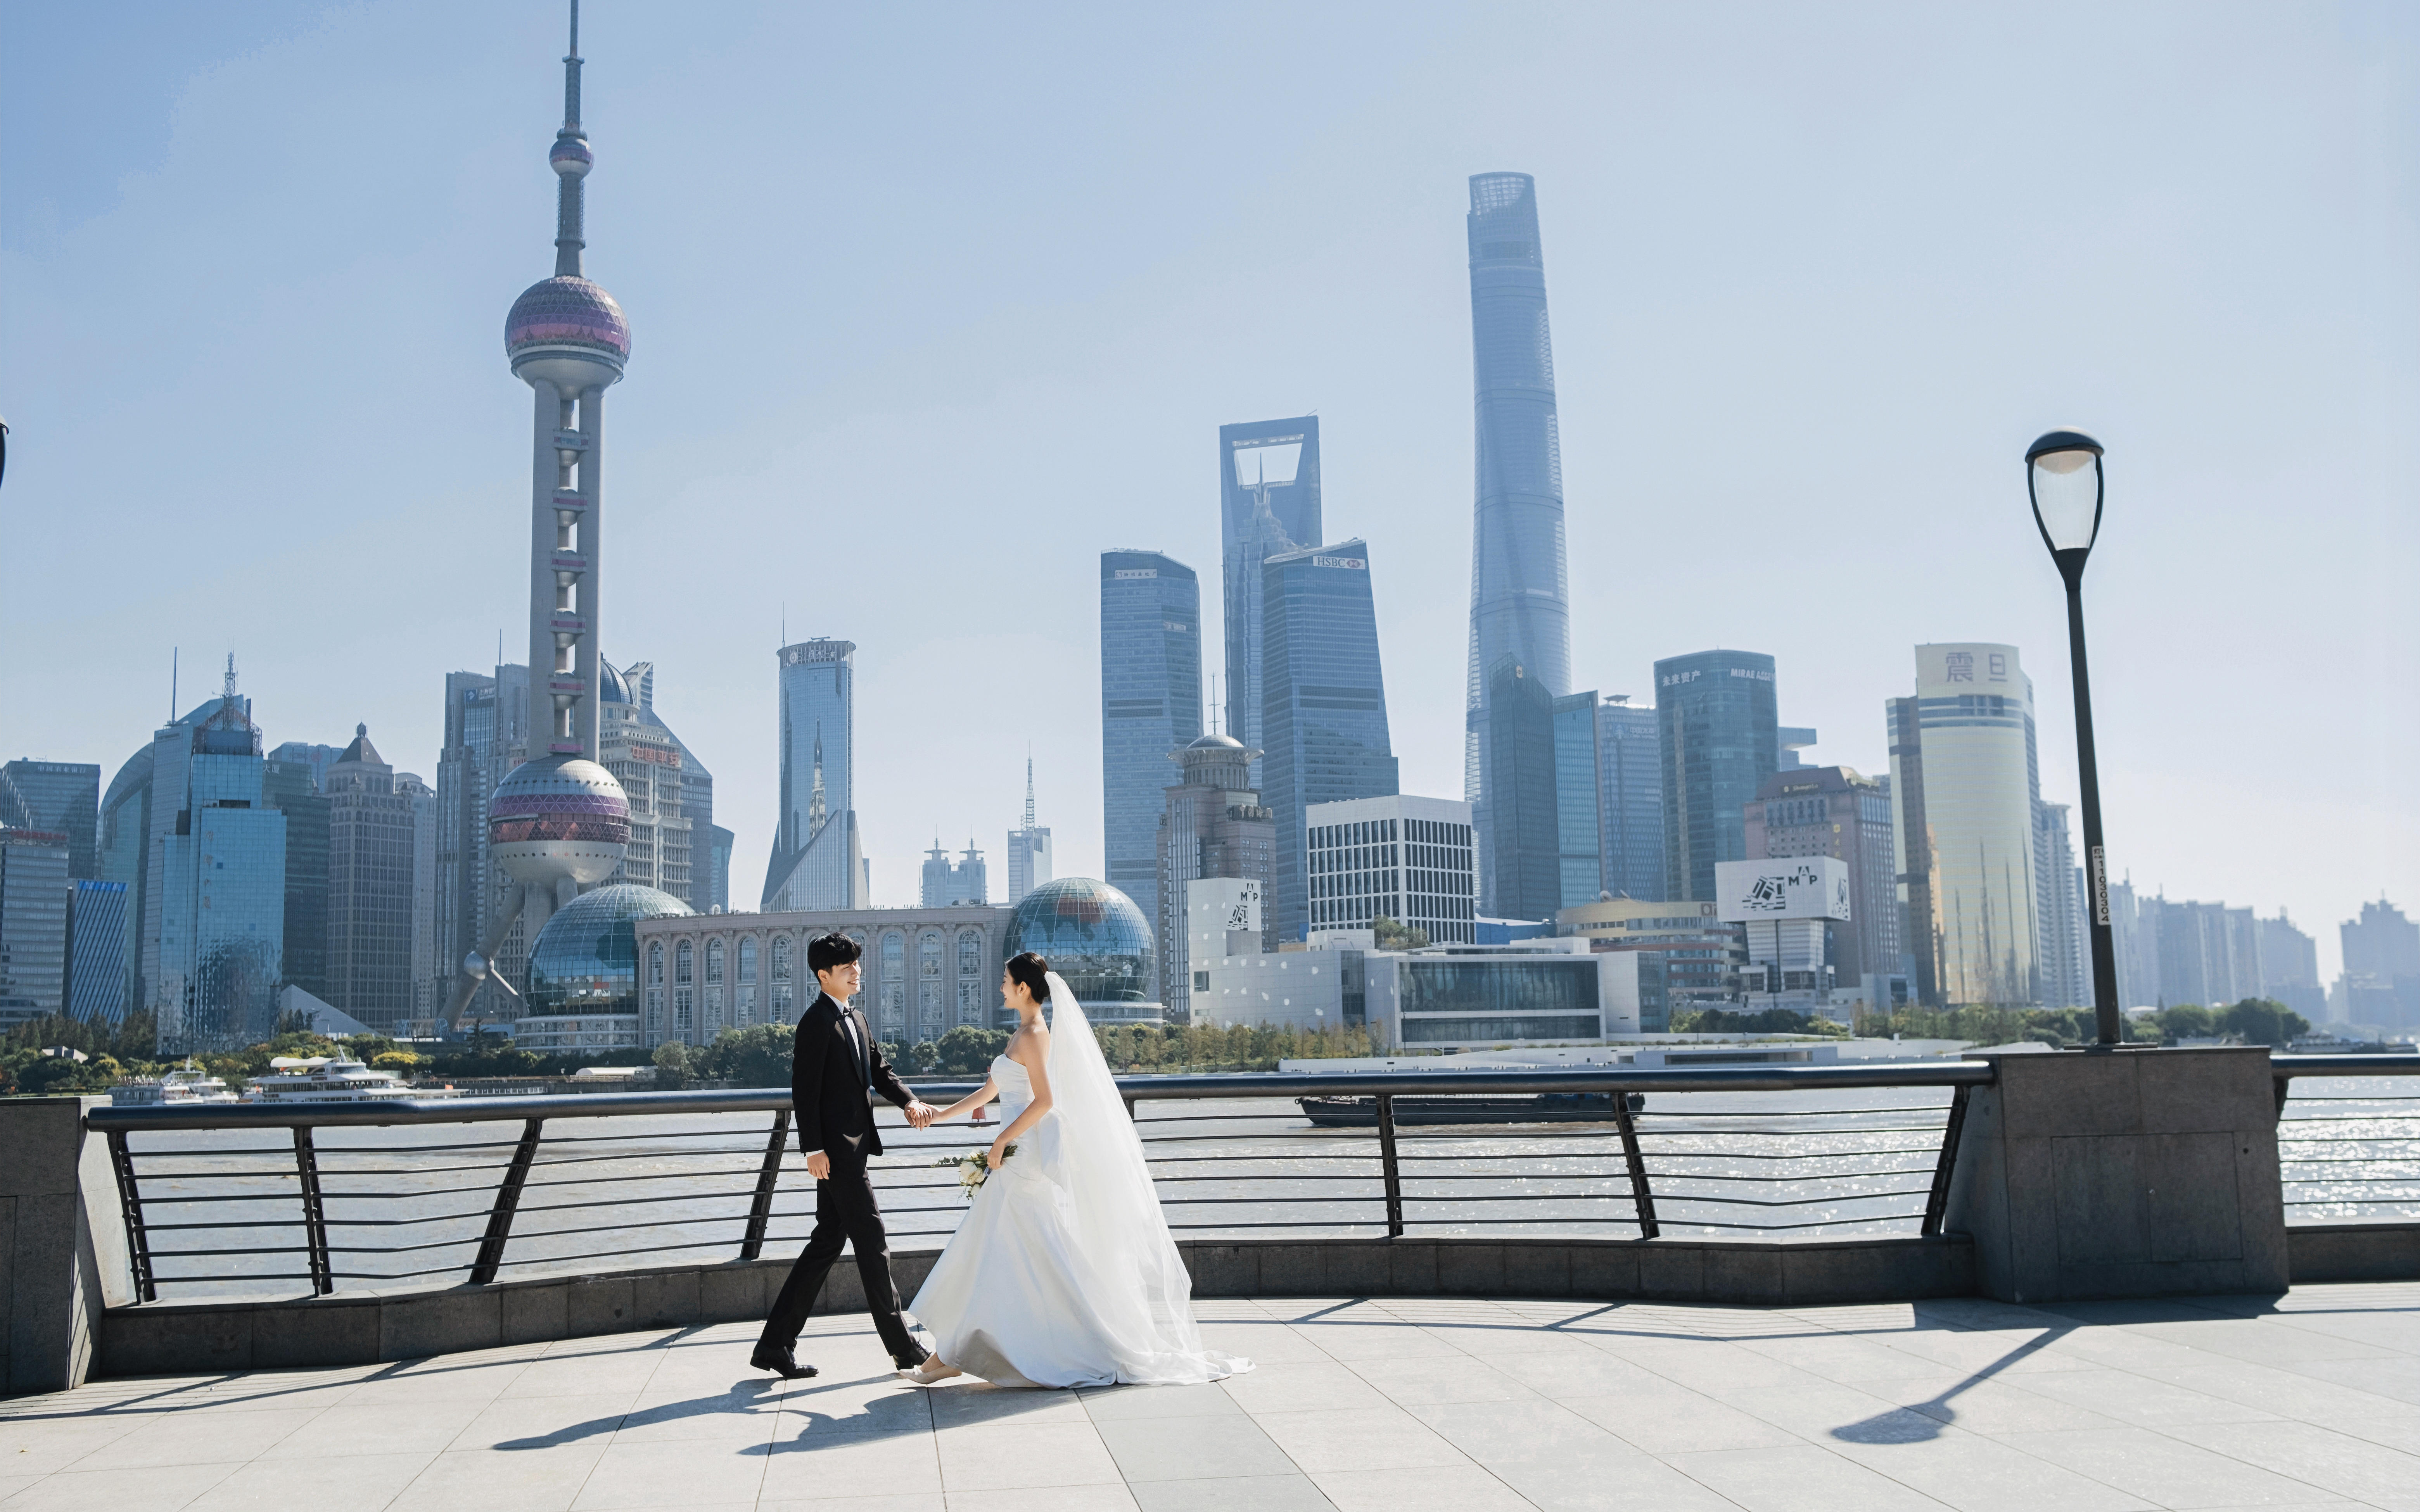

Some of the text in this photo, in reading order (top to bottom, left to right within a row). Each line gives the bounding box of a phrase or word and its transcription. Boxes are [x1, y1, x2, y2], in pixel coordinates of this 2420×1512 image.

[1317, 557, 1345, 567] HSBC
[1730, 668, 1755, 679] MIRAE
[1946, 652, 2008, 682] 震旦
[1663, 670, 1701, 687] 未来资产
[632, 746, 681, 766] 中国平安
[1789, 866, 1817, 886] MAP
[1241, 883, 1258, 901] MAP
